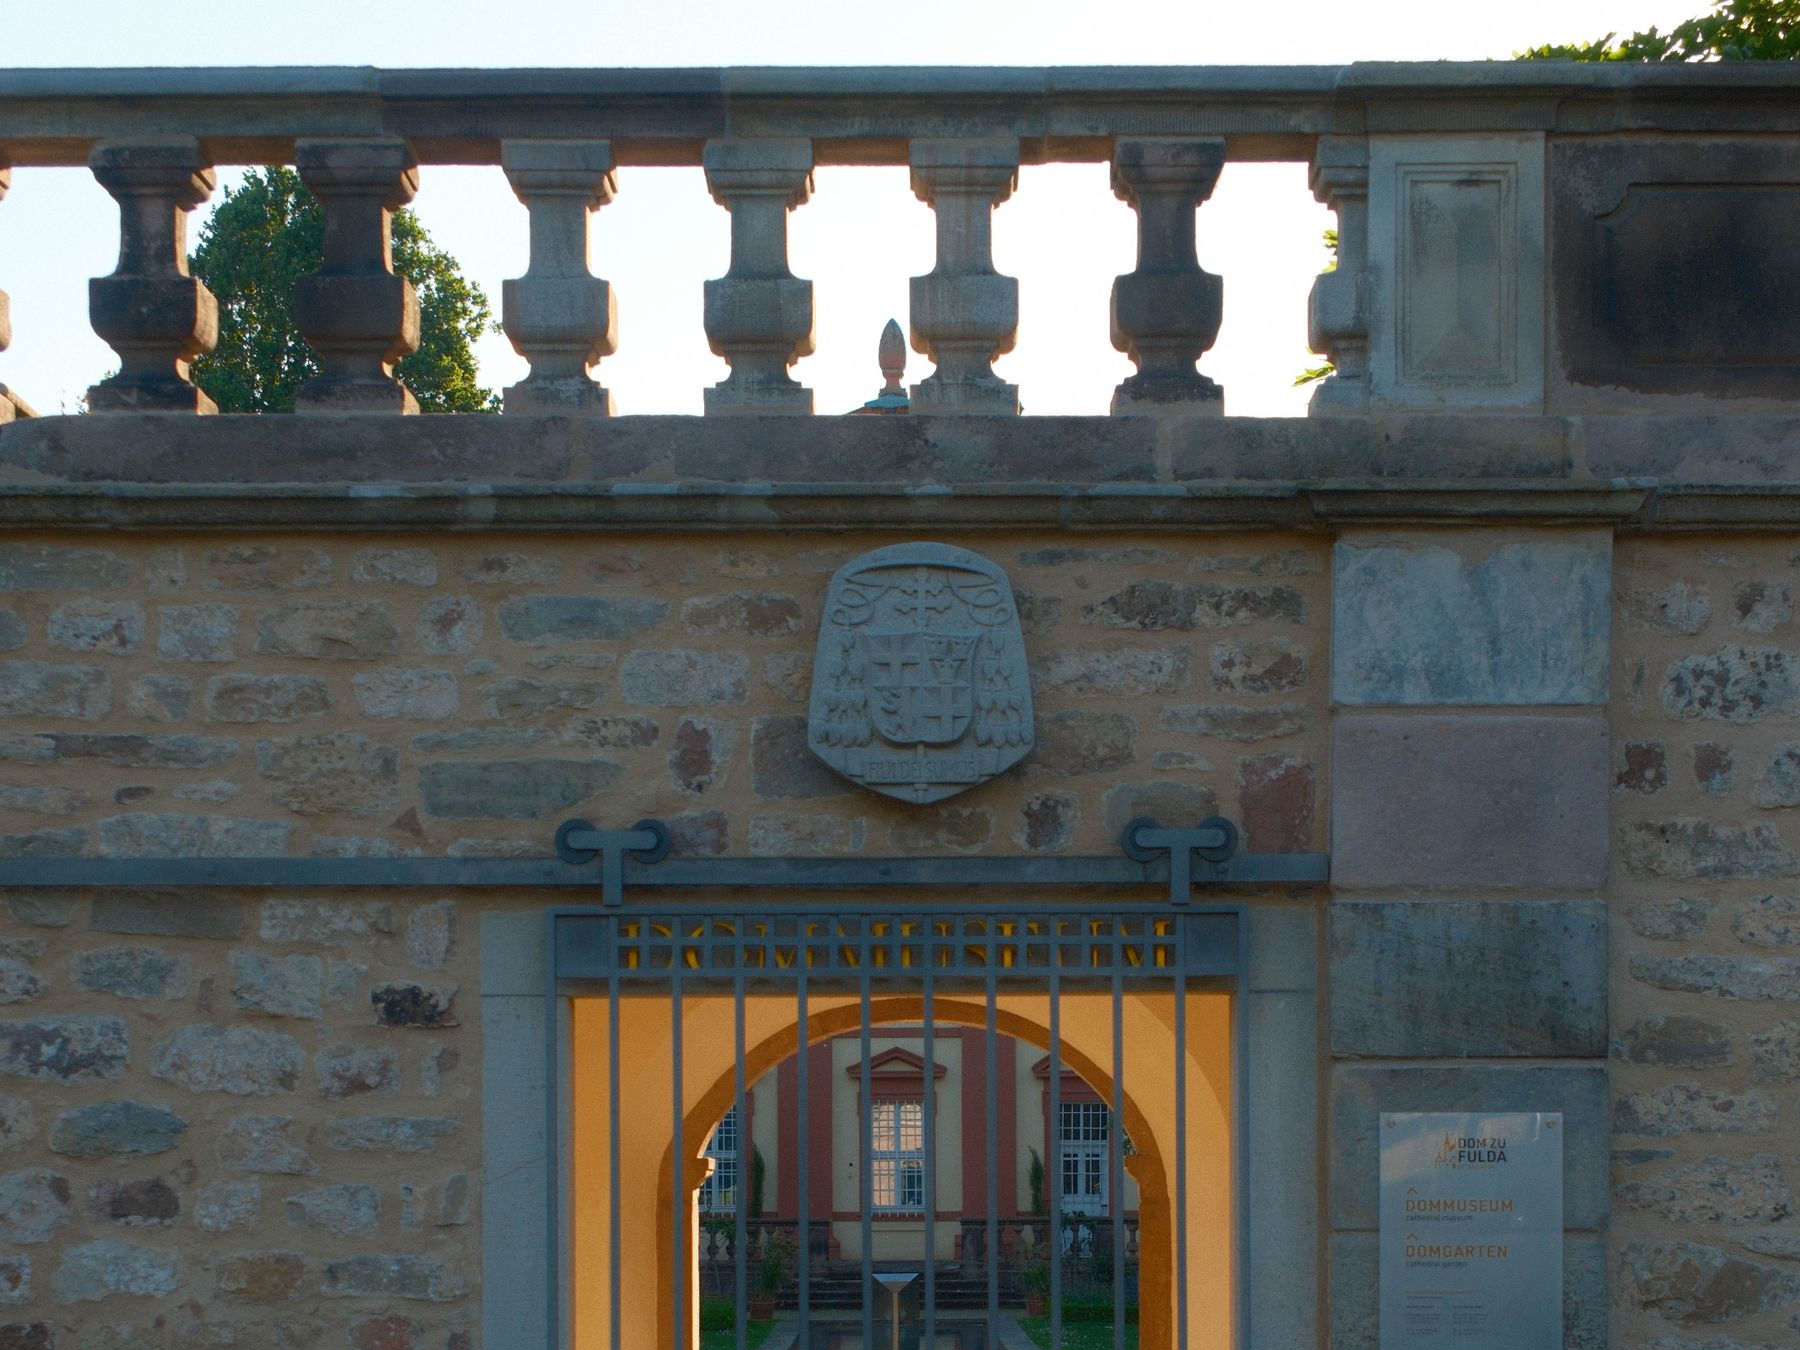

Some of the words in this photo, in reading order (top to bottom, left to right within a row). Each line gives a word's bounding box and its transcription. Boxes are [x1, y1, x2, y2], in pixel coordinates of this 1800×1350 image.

[1458, 1137, 1486, 1149] DOM
[1490, 1137, 1506, 1149] ZU
[1458, 1150, 1507, 1163] FULDA
[1406, 1199, 1513, 1212] DOMMUSEUM
[1406, 1214, 1440, 1222] cathedral
[1406, 1245, 1508, 1258] DOMGARTEN
[1441, 1260, 1468, 1269] garden
